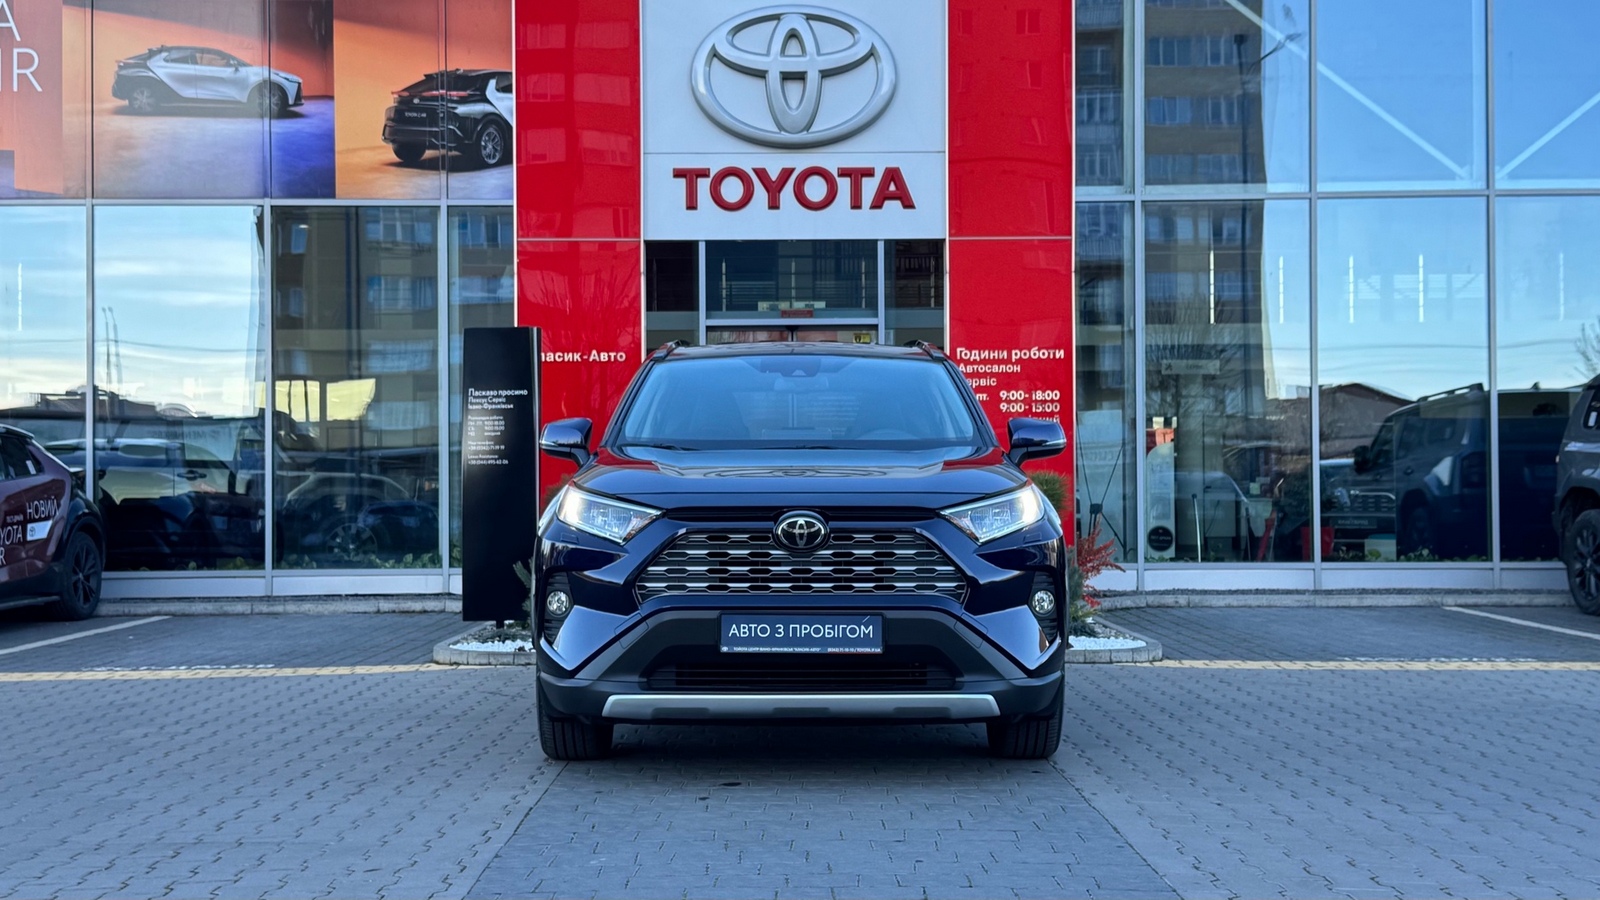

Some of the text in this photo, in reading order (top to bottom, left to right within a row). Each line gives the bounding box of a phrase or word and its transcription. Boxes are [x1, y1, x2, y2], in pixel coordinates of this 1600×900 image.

[0, 48, 43, 92] R
[672, 166, 916, 212] TOYOTA
[956, 346, 1065, 362] Години роботи
[959, 363, 1021, 373] Автосалон
[967, 376, 998, 388] ервіс
[26, 496, 59, 519] НОВИЙ
[728, 623, 874, 639] АВТО З ПРОБІГОМ
